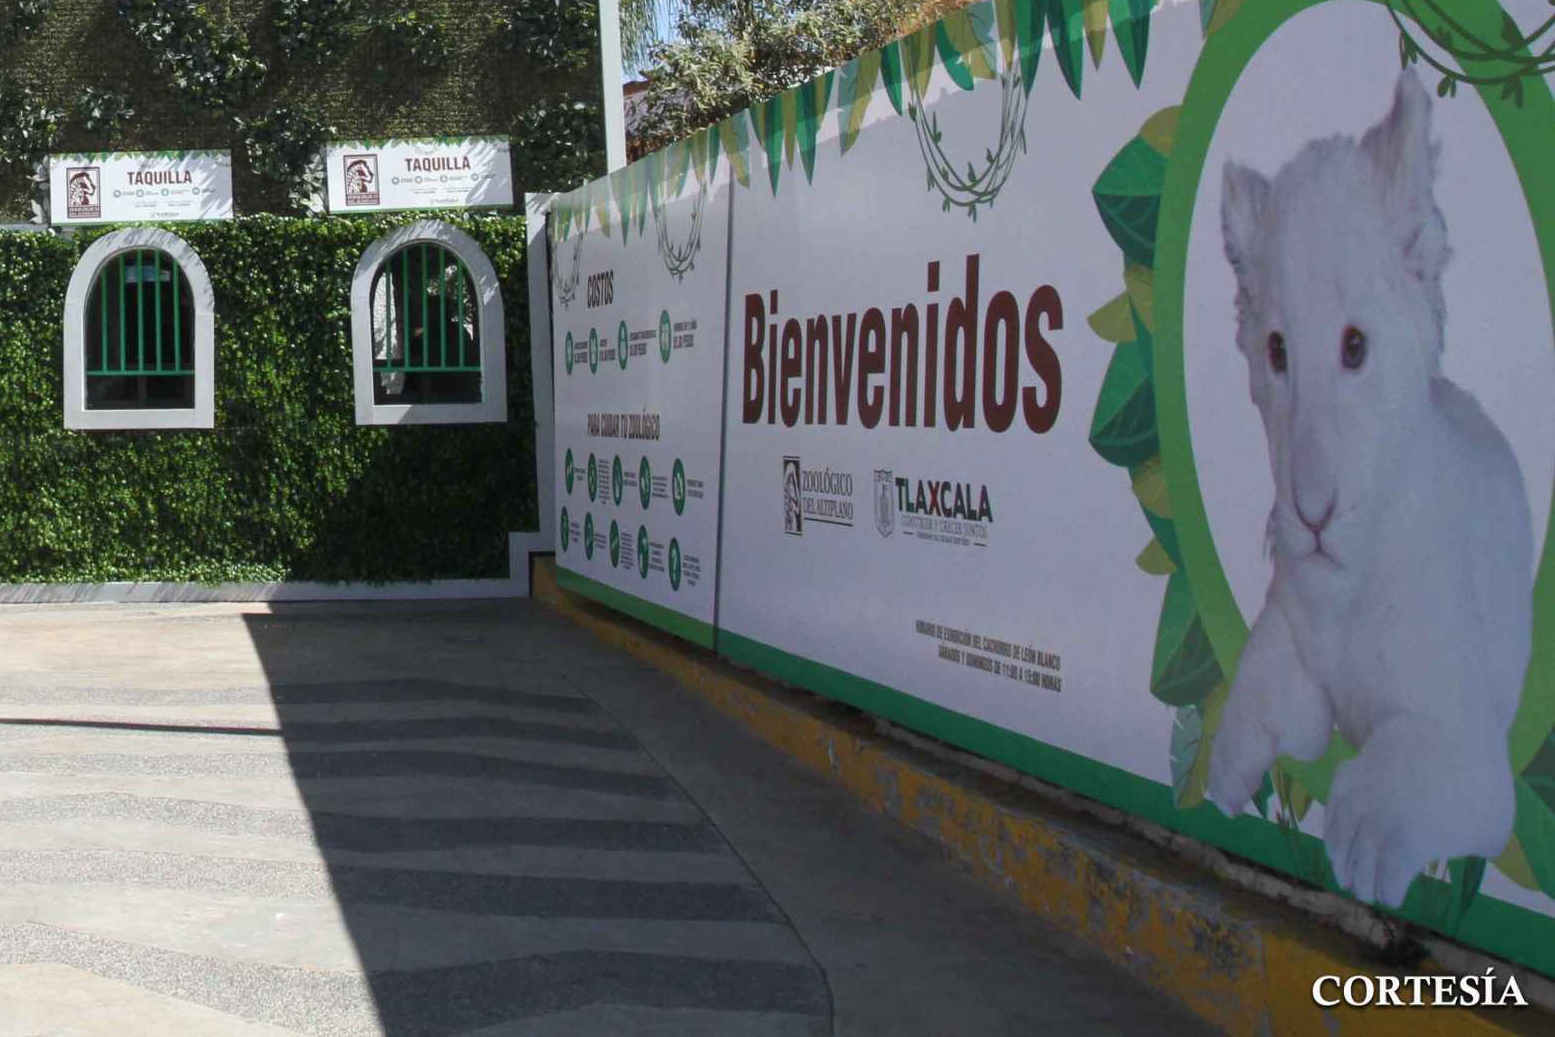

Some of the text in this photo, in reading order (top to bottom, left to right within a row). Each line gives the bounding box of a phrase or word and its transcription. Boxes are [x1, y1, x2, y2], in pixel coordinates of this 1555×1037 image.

[127, 171, 192, 186] TAQUILLA
[405, 156, 471, 172] TAQUILLA
[588, 269, 614, 308] COSTOS
[742, 253, 1064, 434] Bienvenidos
[802, 467, 853, 497] ZOOLÓGICO
[895, 476, 994, 523] TLAXCALA
